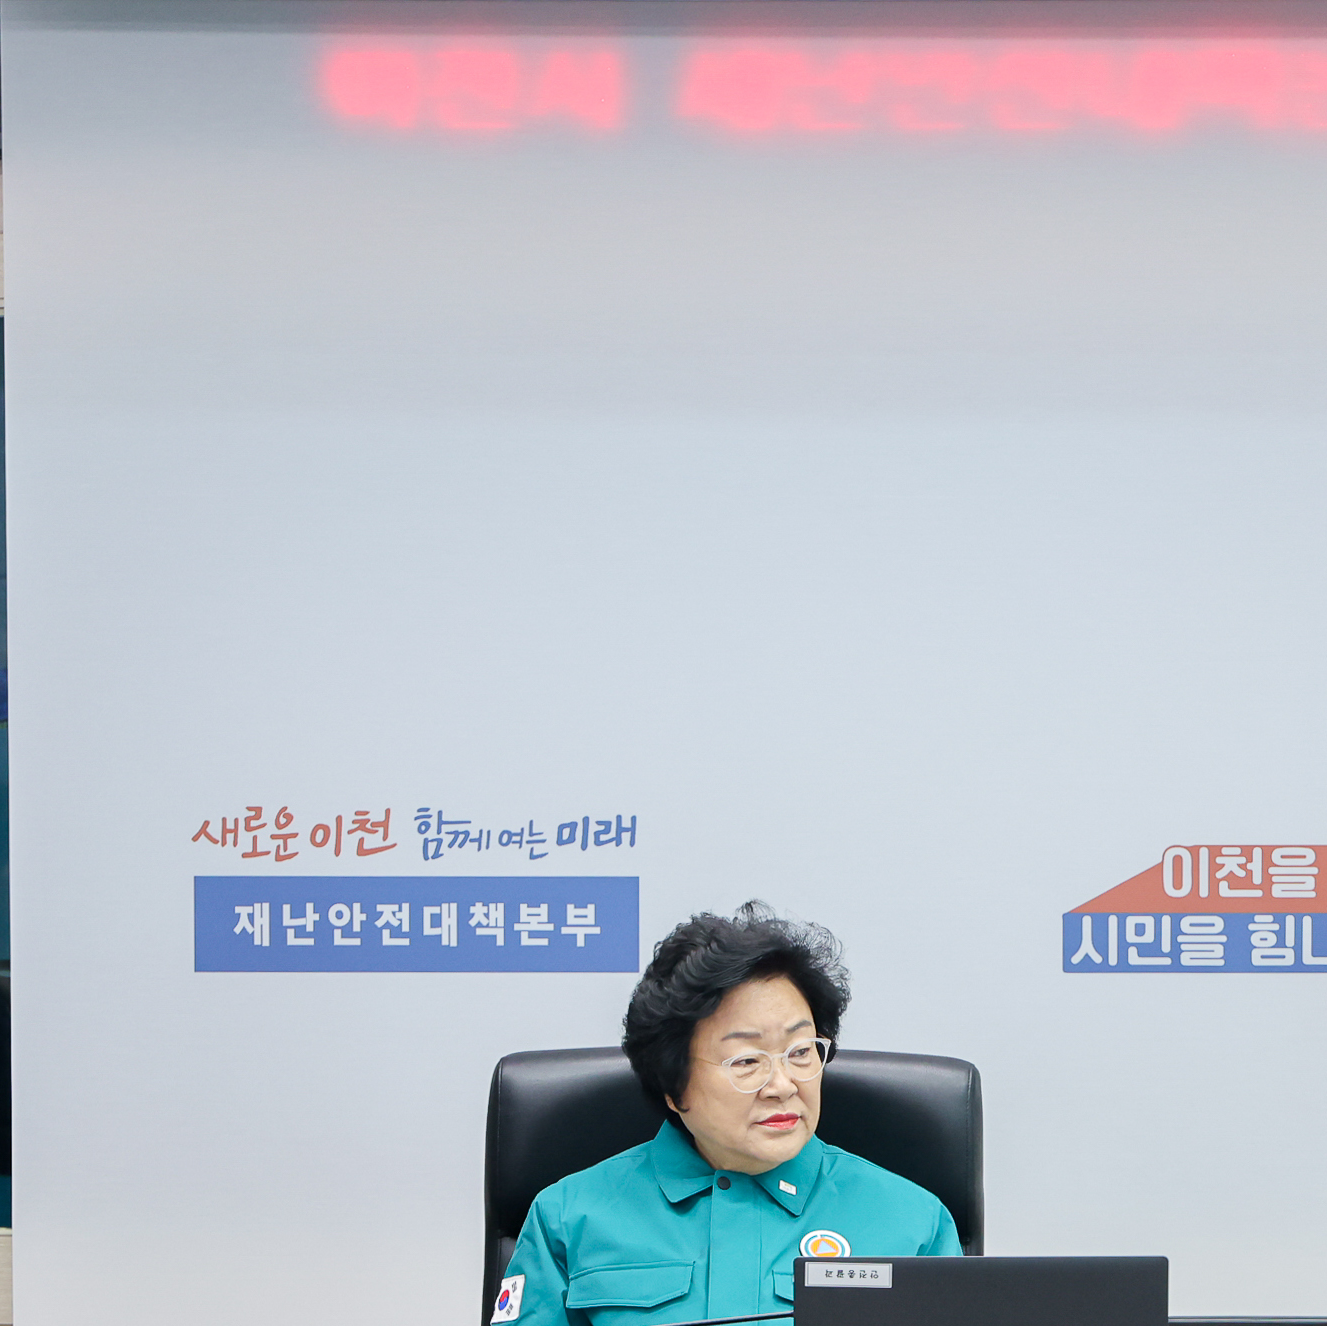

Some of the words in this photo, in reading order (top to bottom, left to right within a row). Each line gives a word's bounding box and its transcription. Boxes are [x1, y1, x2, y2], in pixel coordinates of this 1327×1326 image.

[191, 805, 299, 863] 새로운
[309, 807, 398, 858] 이천
[413, 806, 491, 861] 함께
[497, 818, 549, 860] 여는
[555, 814, 637, 852] 미래
[1161, 846, 1320, 899] 이천을
[232, 901, 603, 948] 재난안전대책본부
[1069, 913, 1228, 967] 시민을
